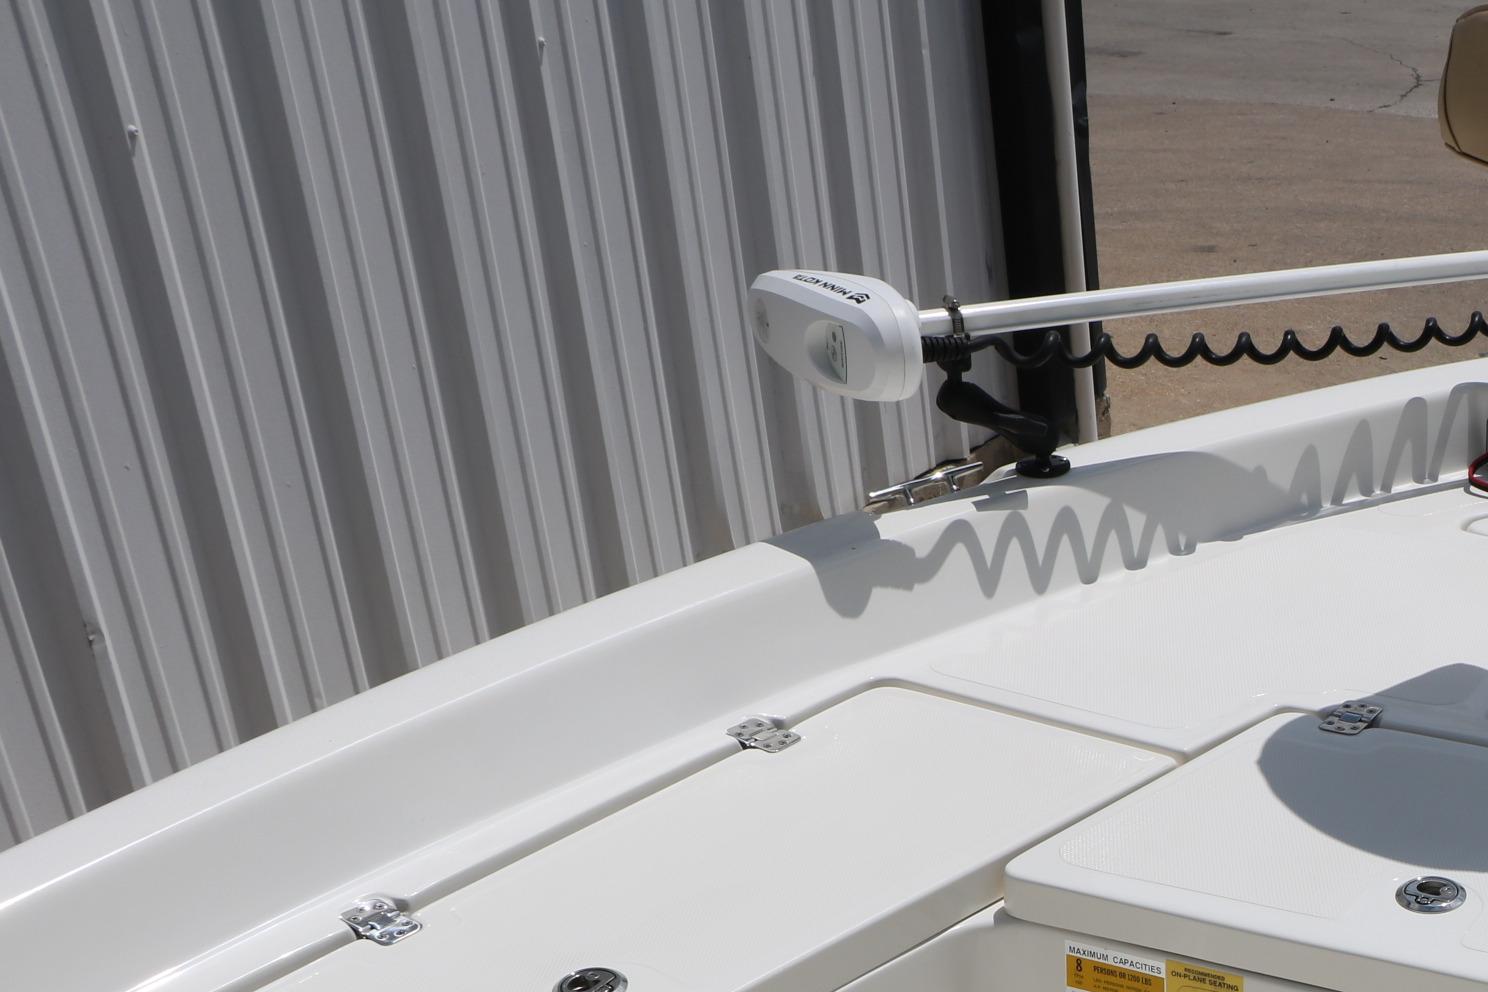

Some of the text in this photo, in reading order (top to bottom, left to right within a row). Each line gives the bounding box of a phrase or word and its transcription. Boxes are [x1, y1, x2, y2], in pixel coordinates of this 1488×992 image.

[820, 282, 852, 297] MINN
[1068, 945, 1162, 975] MAXIMUM CAPACITIES
[1075, 958, 1083, 972] 8
[1093, 965, 1118, 977] PERSONS
[1171, 970, 1239, 992] ON-PLANE SEATING
